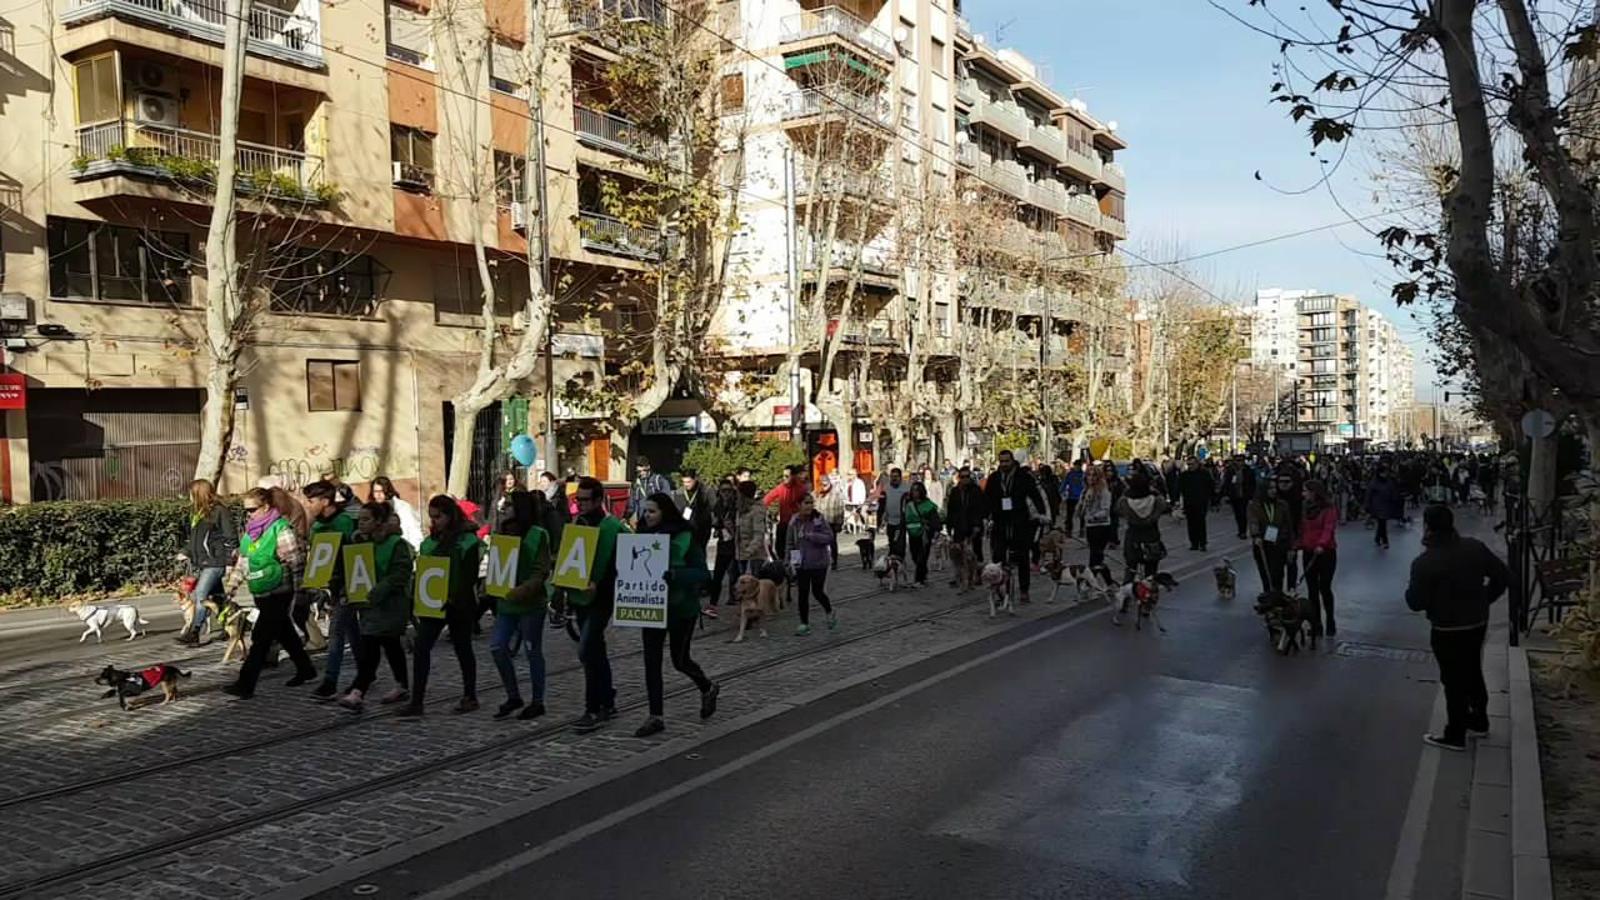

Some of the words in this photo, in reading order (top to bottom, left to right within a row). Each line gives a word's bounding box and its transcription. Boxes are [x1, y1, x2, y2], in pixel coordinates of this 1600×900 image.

[308, 543, 333, 579] P
[349, 554, 373, 594] A
[419, 567, 445, 608] C
[486, 545, 520, 589] M
[558, 536, 588, 579] A
[617, 580, 666, 592] Partido
[616, 593, 665, 605] Animalista
[620, 608, 658, 621] PACMA
